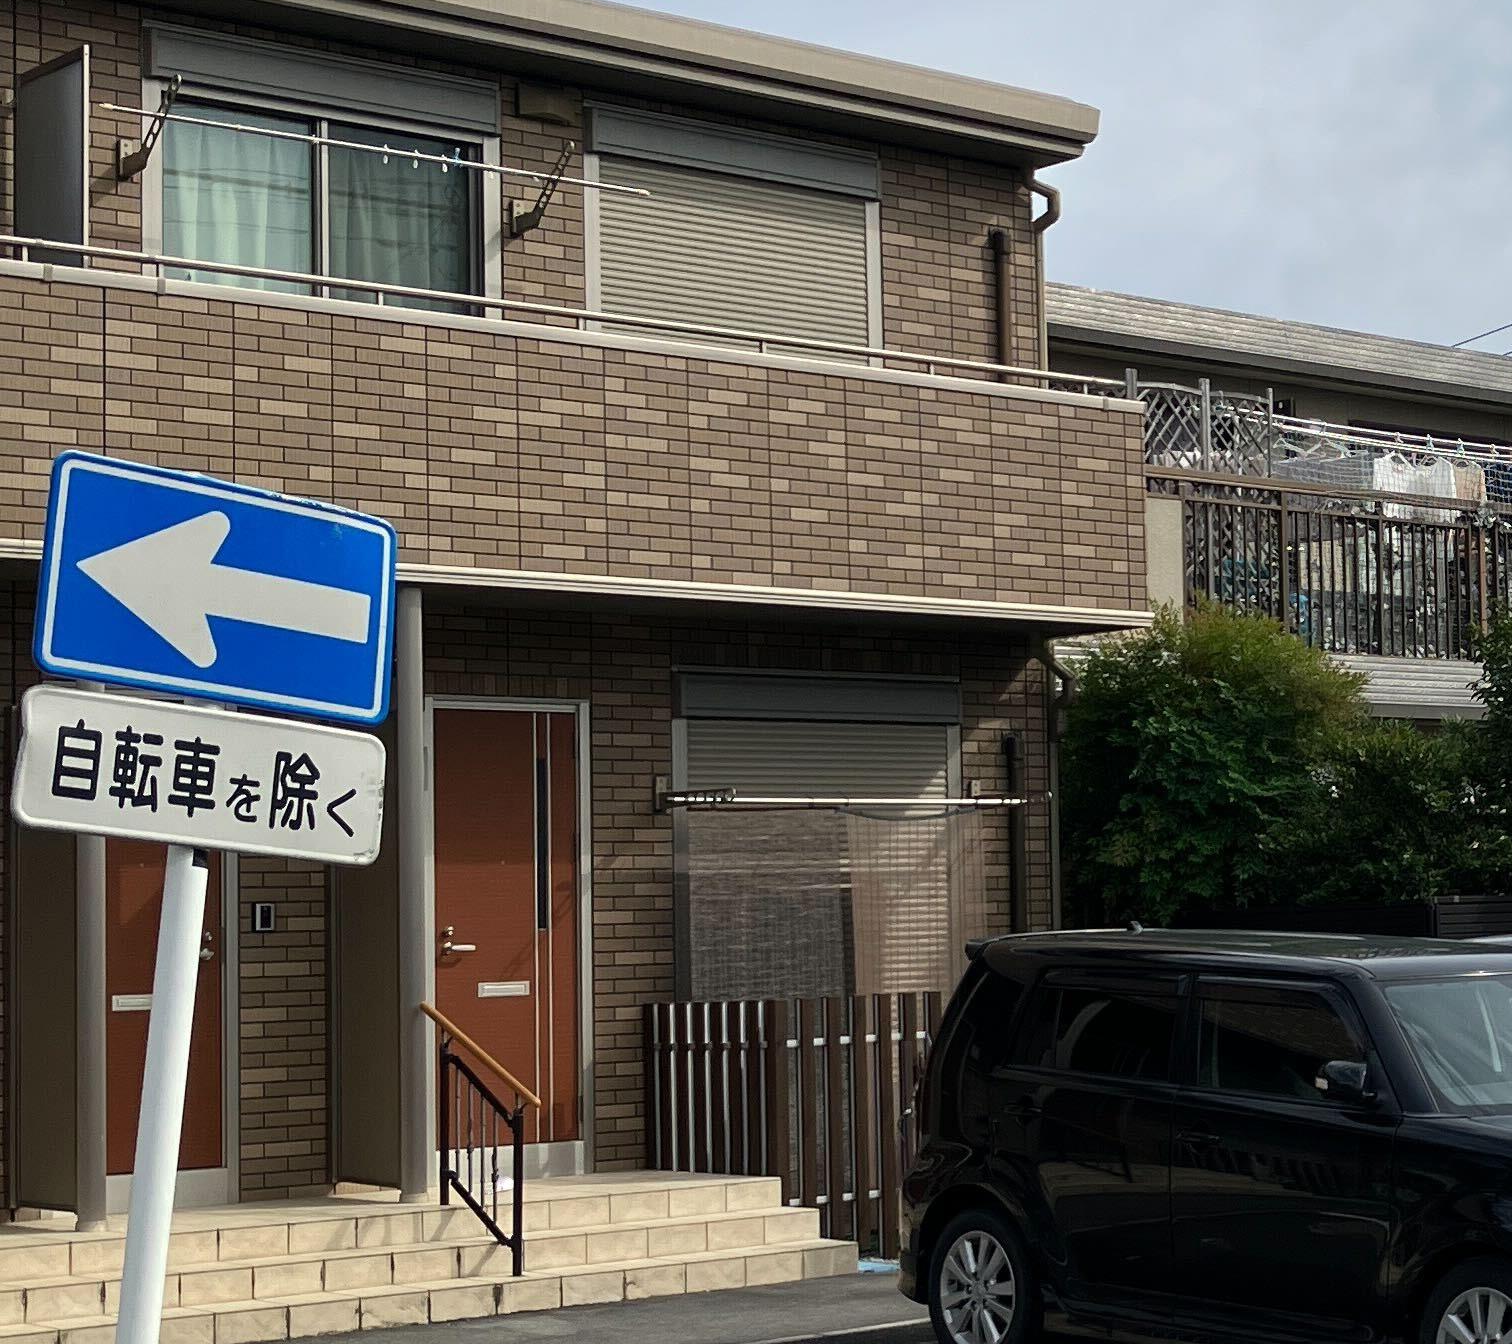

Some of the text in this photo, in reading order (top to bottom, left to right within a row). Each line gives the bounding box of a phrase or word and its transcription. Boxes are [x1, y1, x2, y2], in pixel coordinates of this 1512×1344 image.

[51, 719, 357, 838] 自転車を除く
